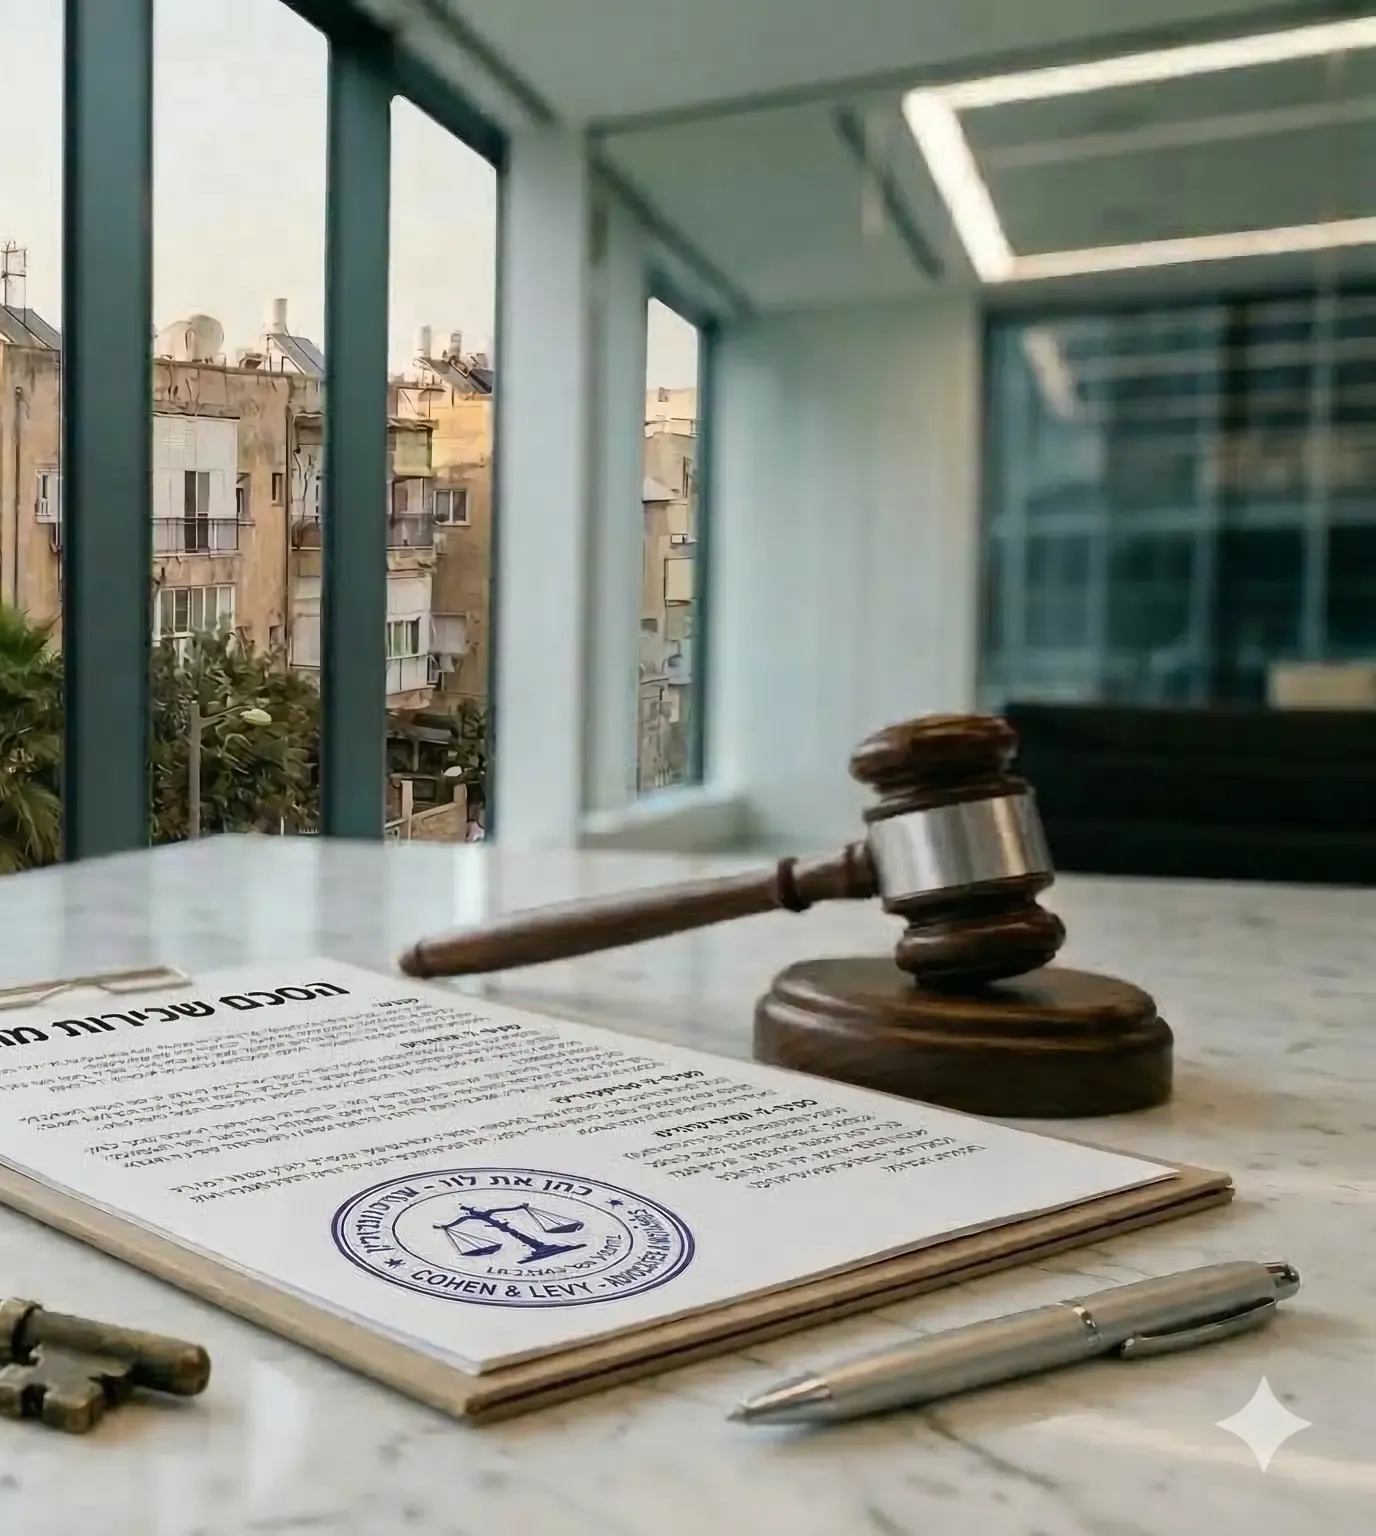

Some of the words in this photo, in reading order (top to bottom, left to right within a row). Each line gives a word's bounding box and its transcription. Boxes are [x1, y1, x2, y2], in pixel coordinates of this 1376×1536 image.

[219, 982, 351, 1011] הסכם
[489, 1175, 533, 1188] את
[411, 1269, 498, 1297] COHEN
[504, 1285, 522, 1298] &
[528, 1281, 594, 1299] LEVY
